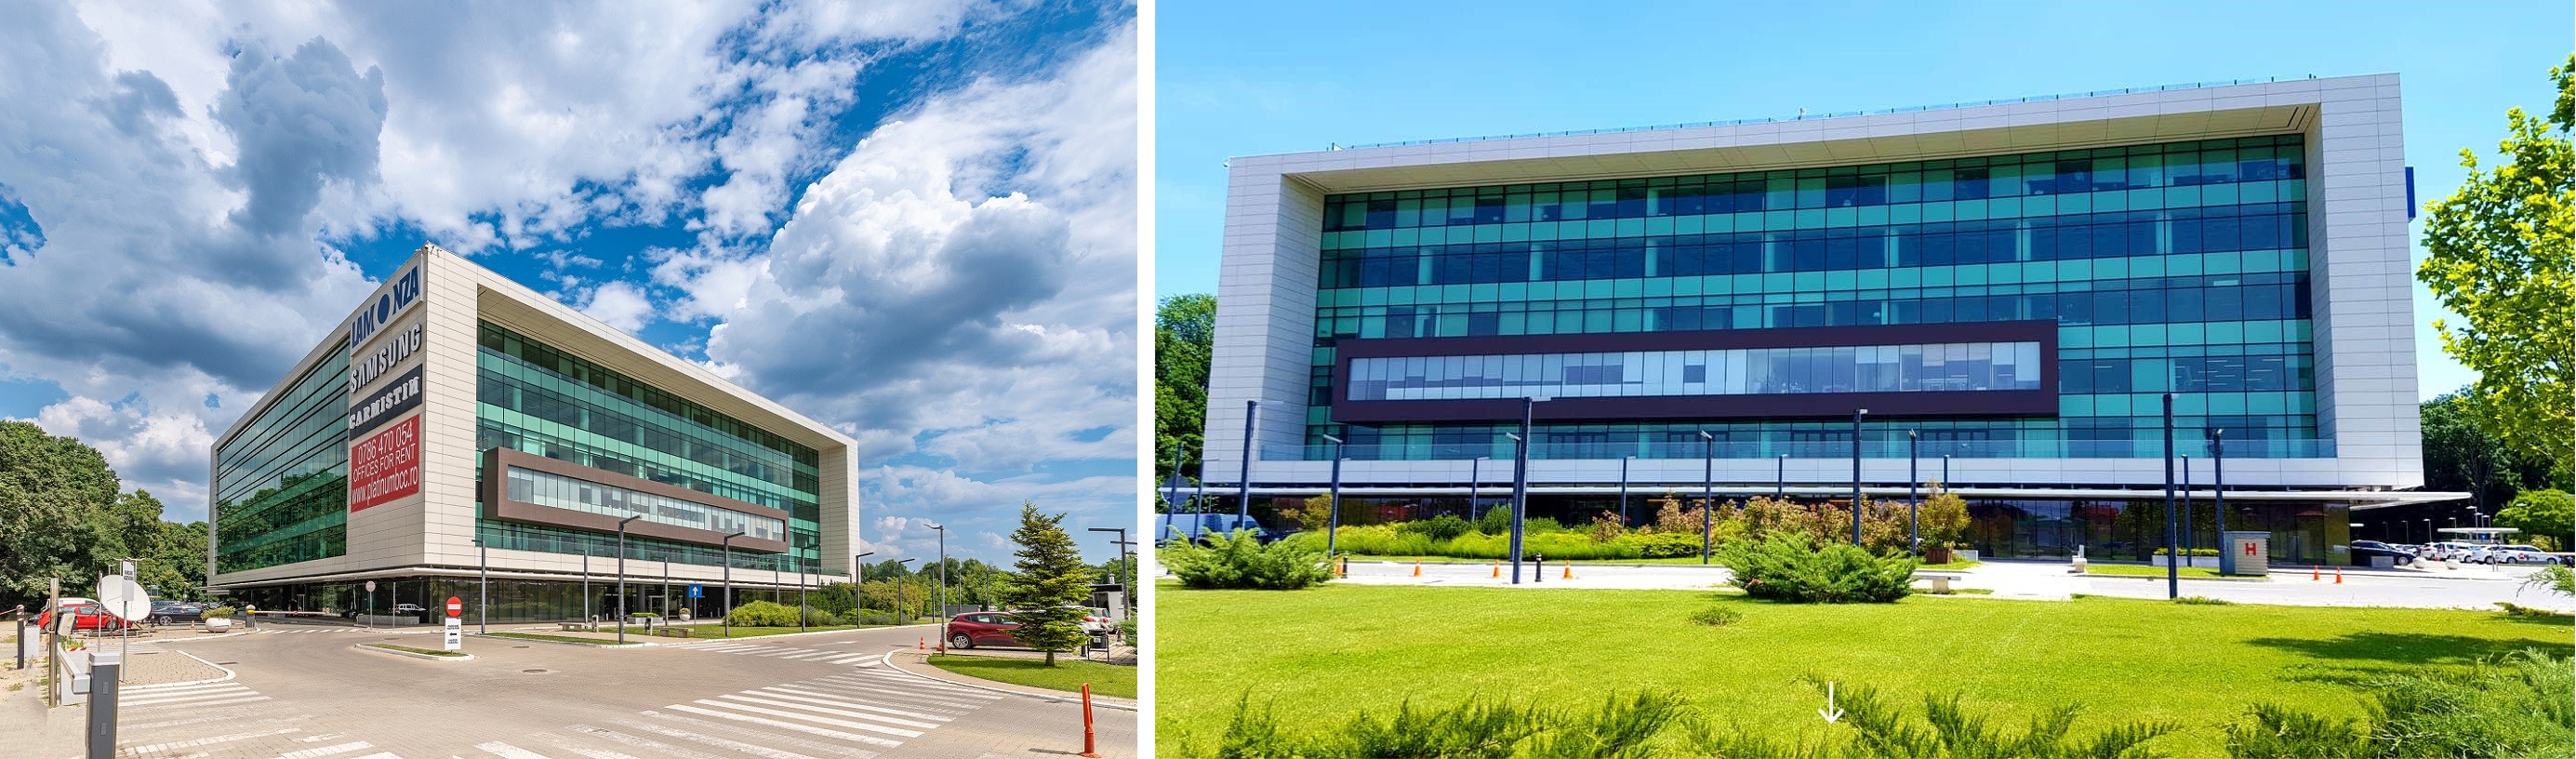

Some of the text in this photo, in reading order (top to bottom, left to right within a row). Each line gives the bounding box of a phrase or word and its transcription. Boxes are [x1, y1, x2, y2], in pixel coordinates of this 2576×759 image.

[351, 323, 421, 392] SAMSUNG
[349, 376, 419, 430] CARMISTIN
[353, 443, 416, 483] OFFICES FOR RENT
[358, 419, 413, 465] 0786 470 054
[352, 466, 418, 506] www.platinumbcc.ro
[2245, 542, 2257, 556] H
